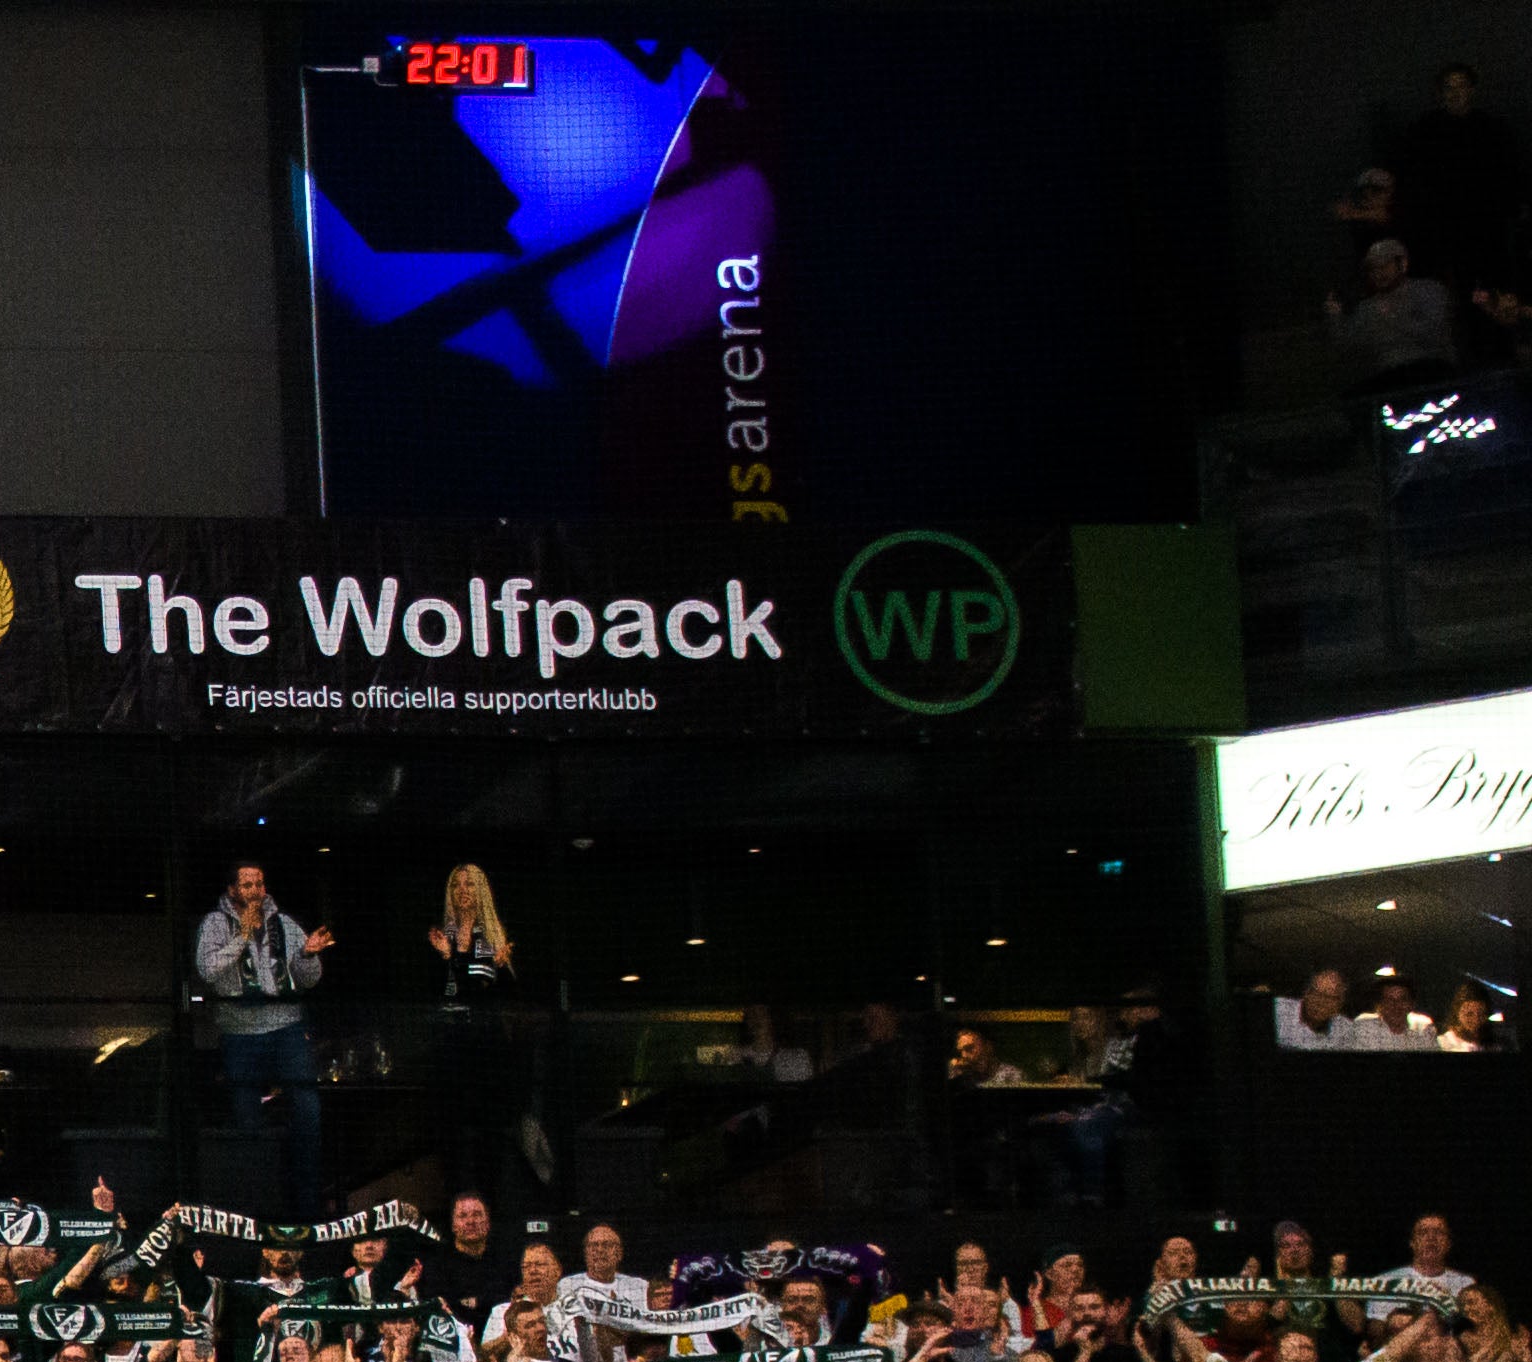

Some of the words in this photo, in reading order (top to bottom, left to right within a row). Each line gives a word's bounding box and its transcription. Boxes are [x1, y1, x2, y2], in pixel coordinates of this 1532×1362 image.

[407, 44, 527, 85] 22:01
[74, 576, 271, 658] The
[301, 576, 783, 678] Wolfpack
[850, 590, 1004, 661] WP
[207, 683, 344, 711] Färjestads
[351, 683, 457, 711] officiella
[463, 685, 658, 713] supporterklubb
